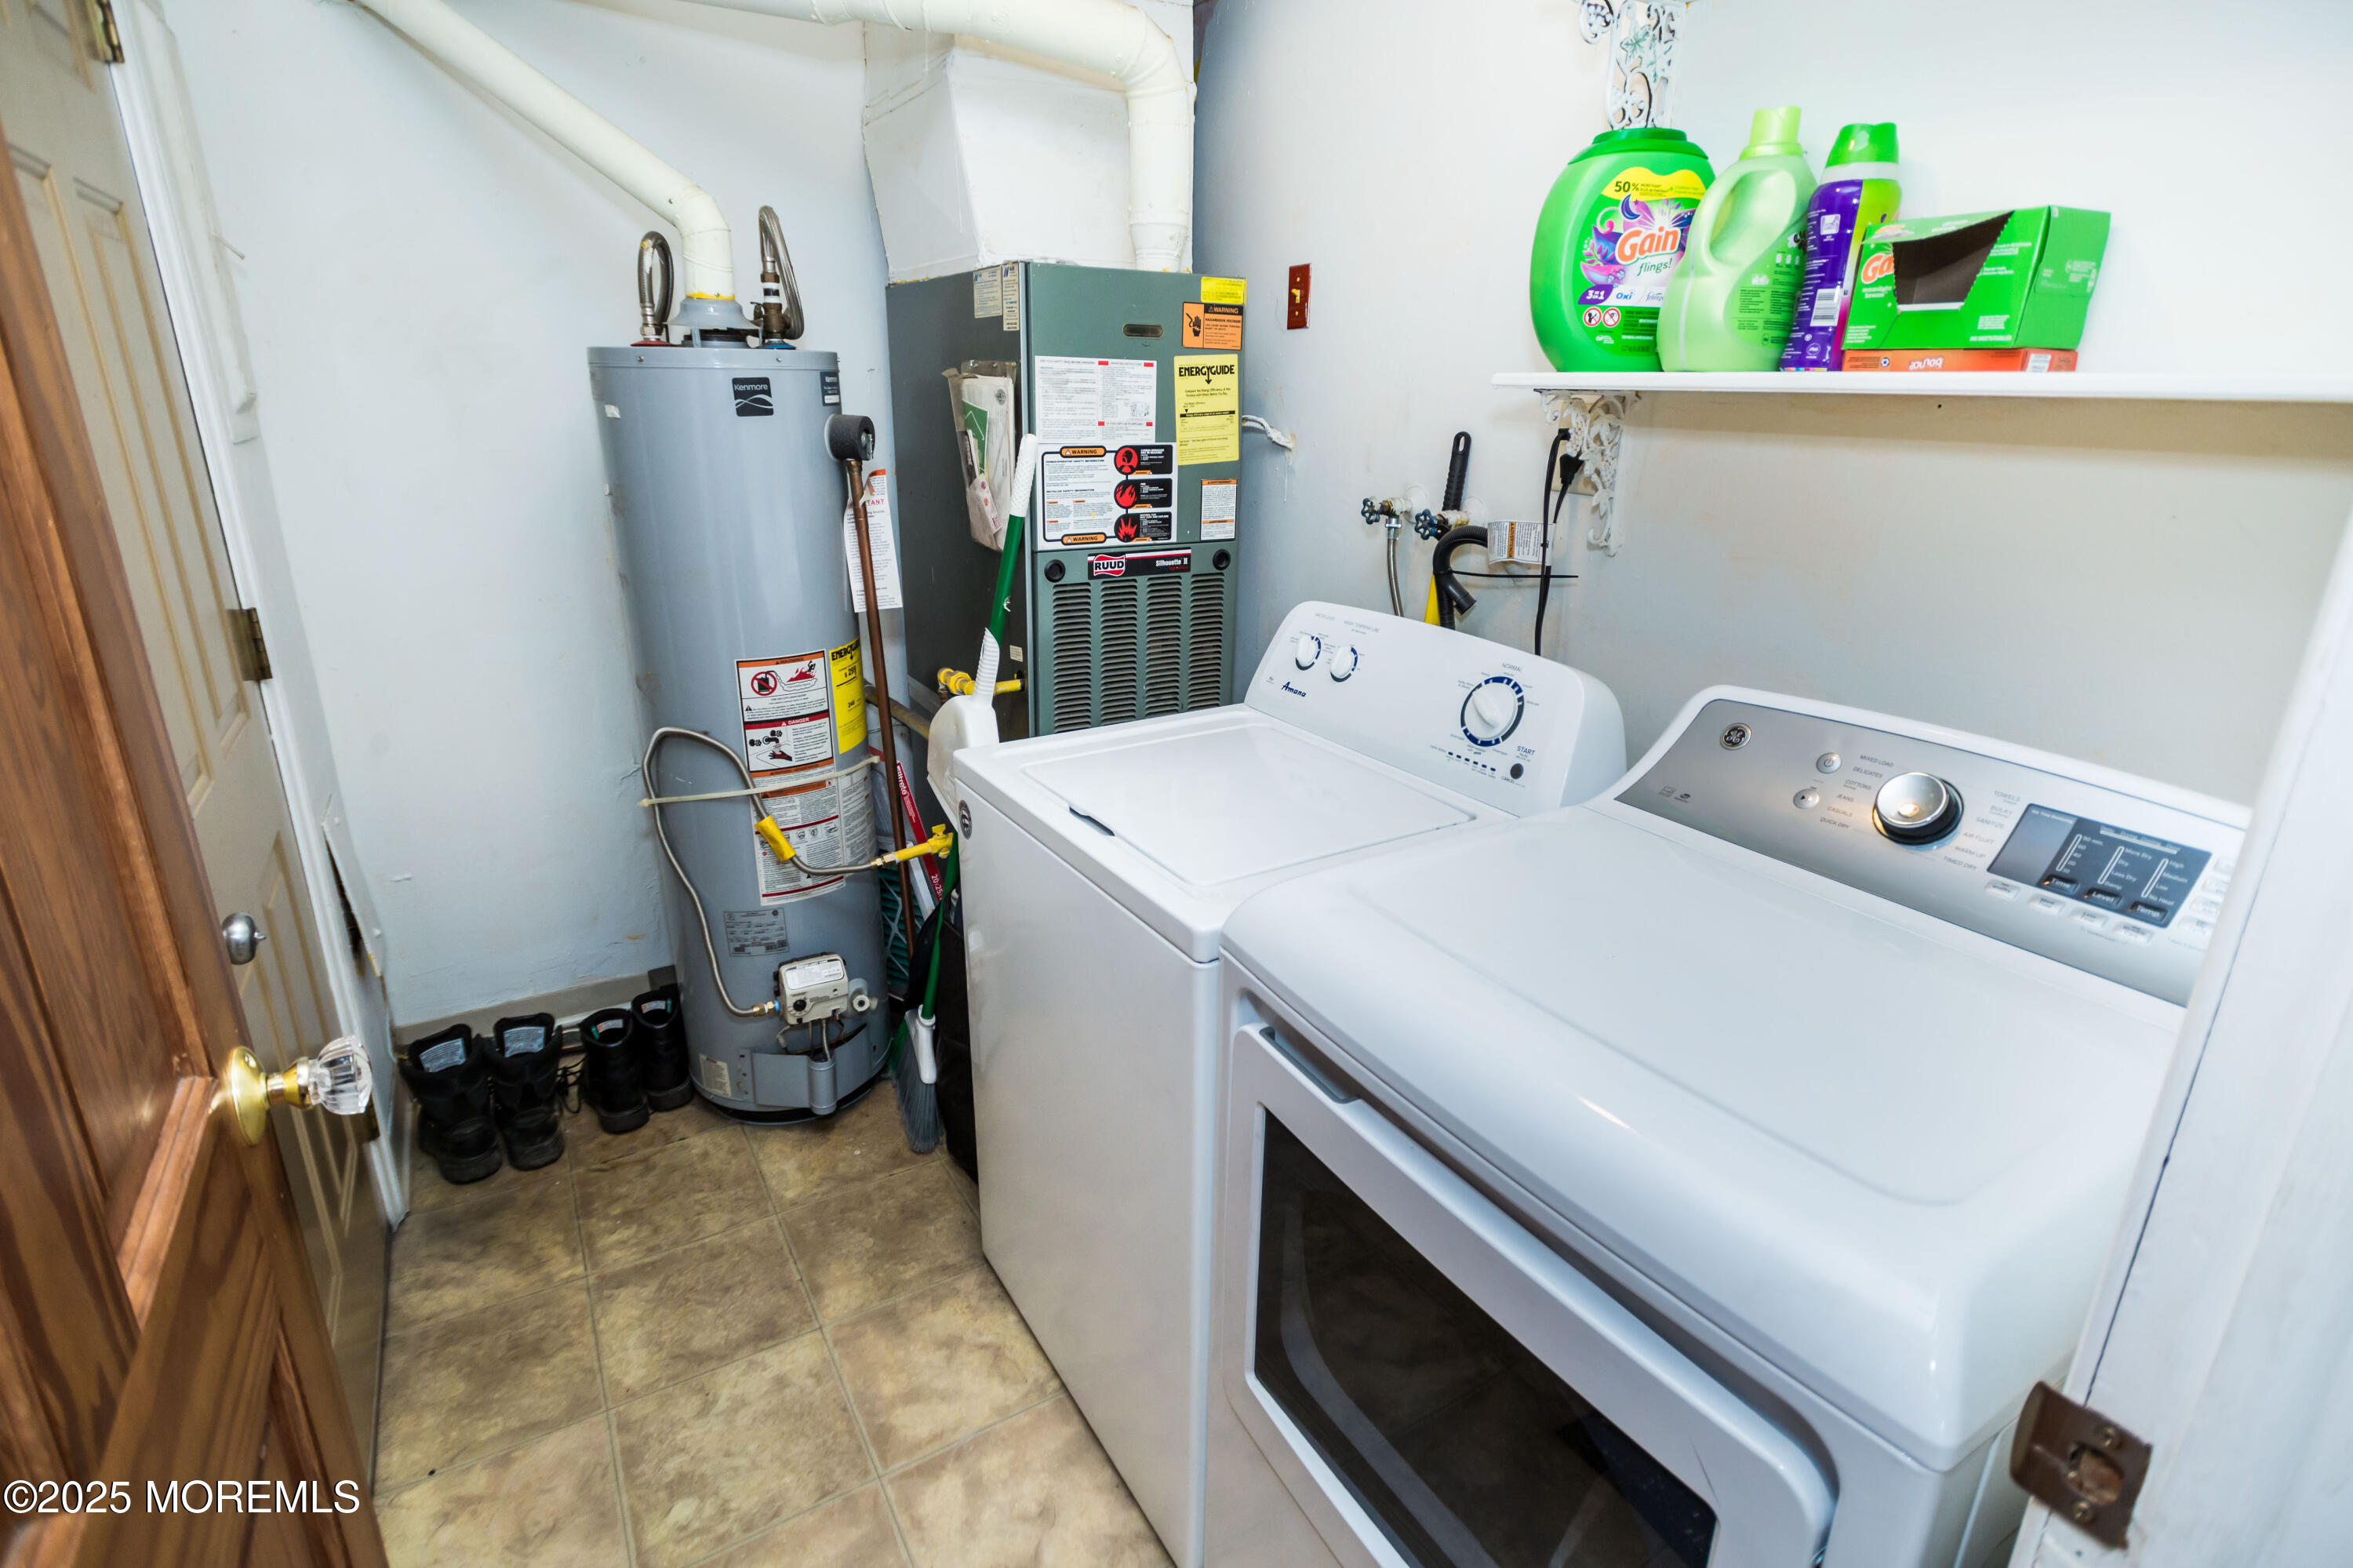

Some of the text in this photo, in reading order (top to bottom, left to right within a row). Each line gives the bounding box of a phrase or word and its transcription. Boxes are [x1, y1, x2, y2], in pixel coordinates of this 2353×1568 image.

[1617, 226, 1679, 263] Gain
[1636, 257, 1673, 277] flings!
[1862, 253, 1895, 284] Ga
[1616, 292, 1634, 300] Oxi
[1178, 364, 1235, 377] ENERGYGUIDE
[1094, 560, 1125, 571] RUUD
[1155, 558, 1182, 567] Silhouette
[1501, 662, 1523, 672] NORMAL
[1281, 681, 1307, 697] Amana
[787, 717, 810, 726] DANGER
[1516, 745, 1536, 756] START
[1860, 755, 1878, 763] MIXED
[1853, 766, 1883, 779] DELICATES
[1500, 775, 1515, 785] CANCEL
[1845, 779, 1872, 791] COTTONS
[1836, 794, 1854, 802] JEANS
[1994, 790, 2021, 802] TOWELS
[1827, 806, 1853, 817] CASUALS
[1990, 805, 2013, 815] BULKY
[1820, 817, 1837, 826] QUICK
[1976, 817, 2005, 829] SANITIZE
[1955, 846, 1976, 856] WARM
[2125, 848, 2140, 857] More
[1944, 856, 1977, 871] TIMED DRY
[2111, 870, 2137, 882] Less Dry
[2162, 871, 2188, 883] Medium
[2051, 878, 2071, 889] Time
[2104, 880, 2122, 890] Damp
[2092, 891, 2115, 903] Level
[2158, 897, 2175, 906] Heat
[2137, 905, 2161, 918] Temp
